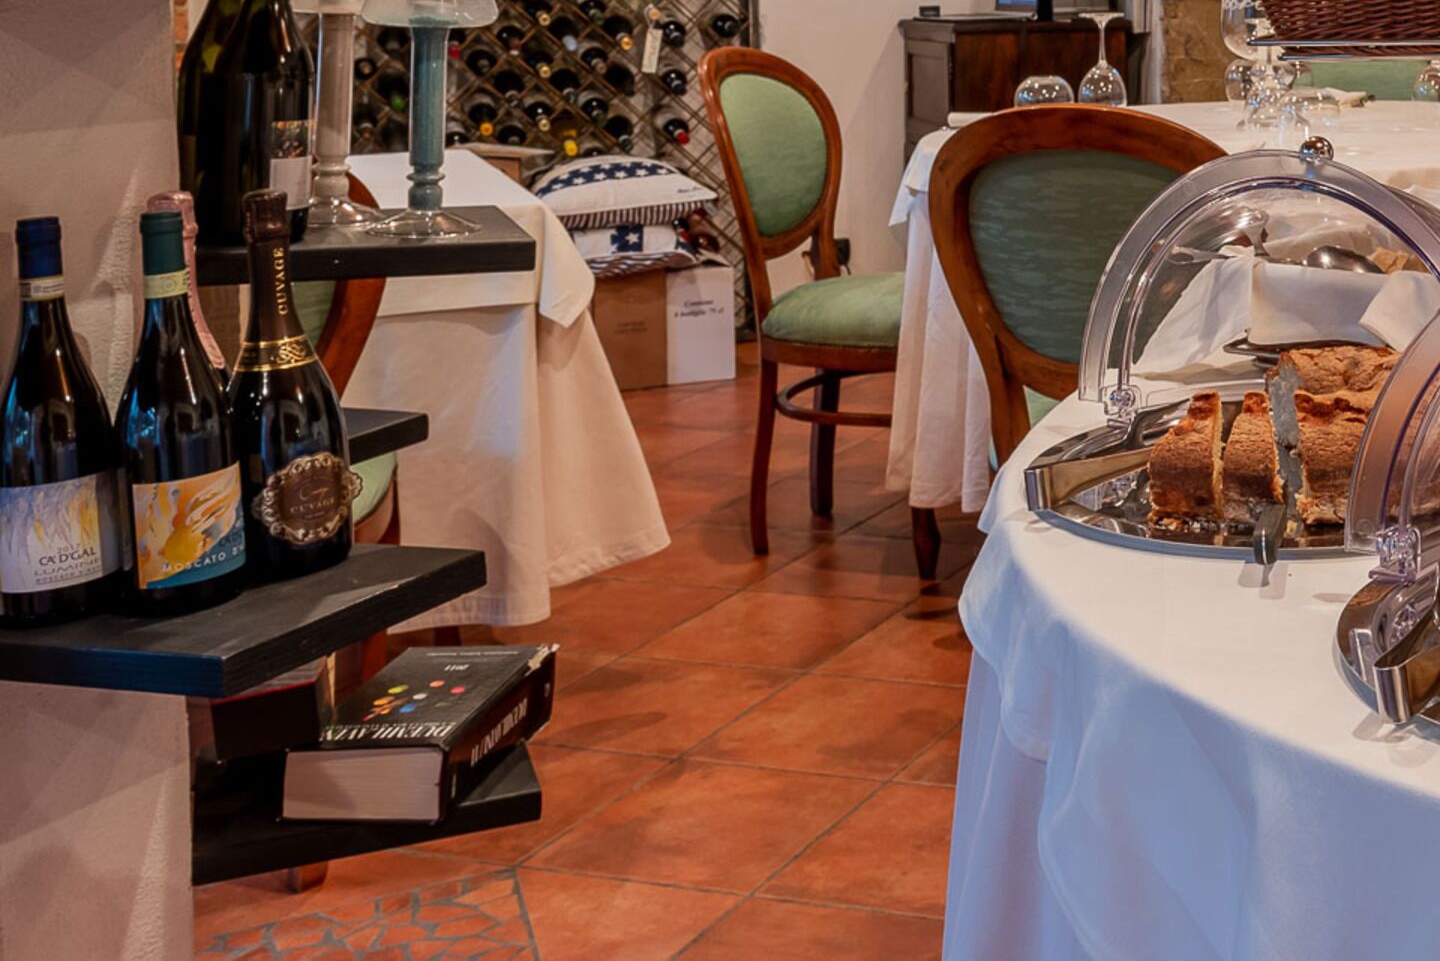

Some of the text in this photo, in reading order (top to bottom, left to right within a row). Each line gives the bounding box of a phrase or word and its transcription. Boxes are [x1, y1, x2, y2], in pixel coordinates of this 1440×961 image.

[272, 247, 289, 316] CUVAGE
[290, 498, 335, 514] CUVAGE
[162, 552, 227, 571] MOSCATO
